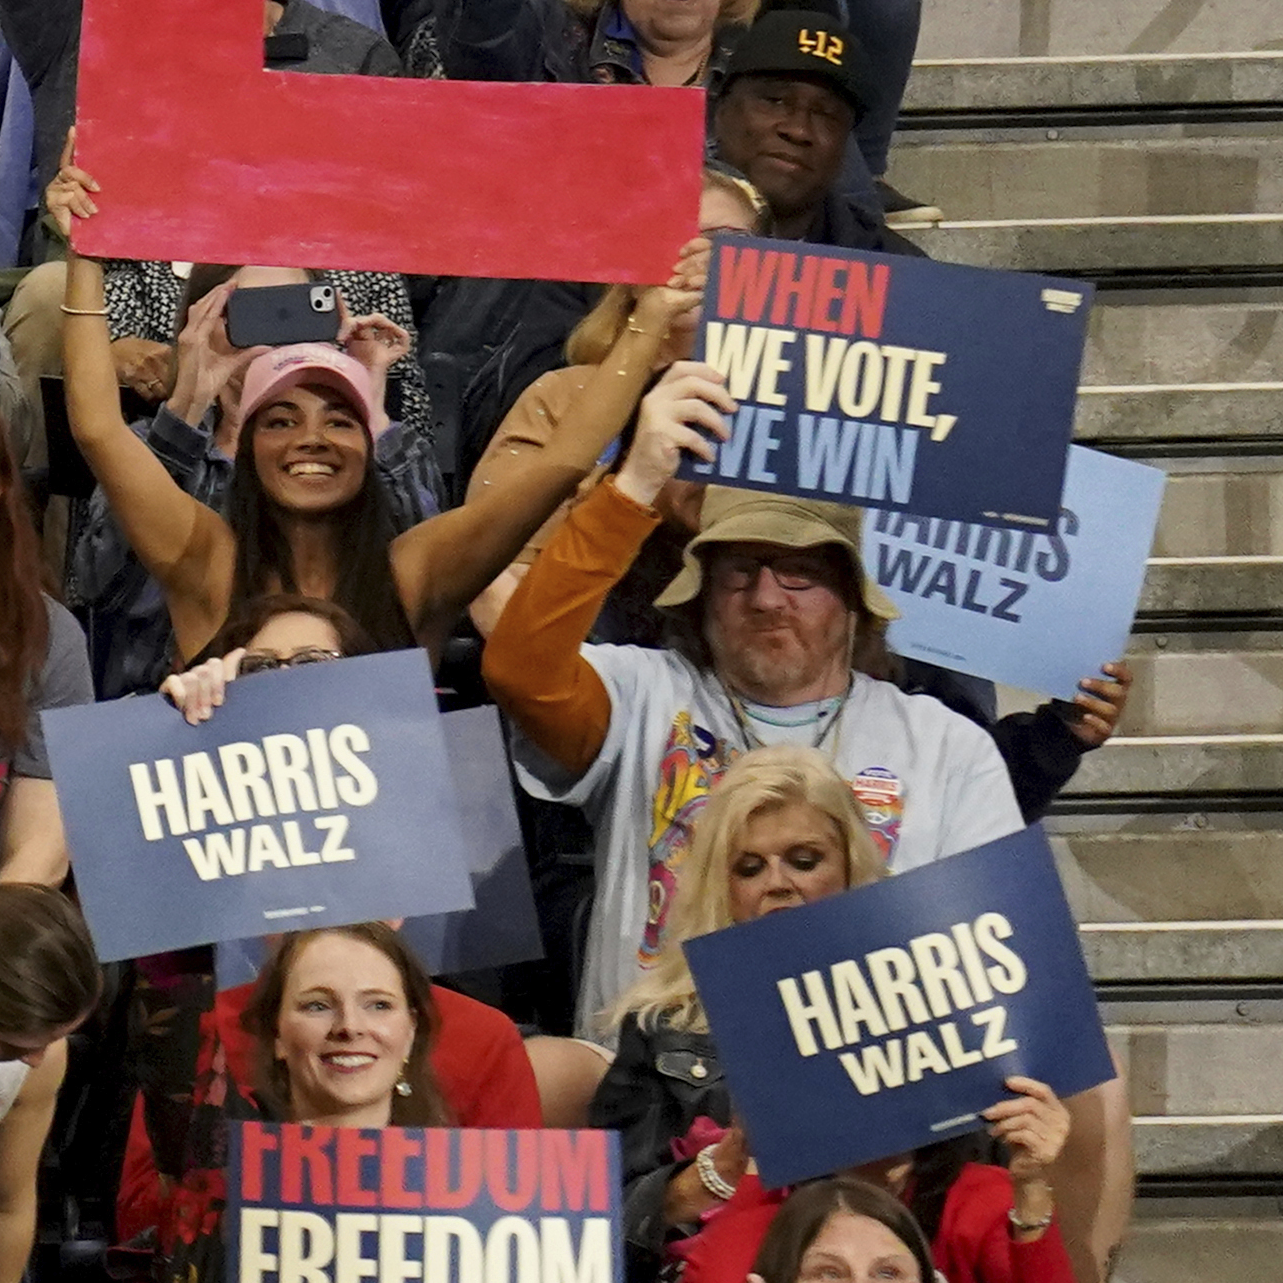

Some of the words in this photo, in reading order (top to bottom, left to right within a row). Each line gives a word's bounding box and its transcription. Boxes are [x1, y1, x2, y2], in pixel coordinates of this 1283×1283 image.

[717, 245, 892, 339] WHEN
[706, 320, 798, 406] WE
[804, 336, 959, 442] VOTE,
[796, 413, 920, 506] WIN
[876, 543, 1029, 624] WALZ
[130, 723, 379, 842] HARRIS
[182, 814, 357, 882] WALZ
[777, 912, 1028, 1058] HARRIS
[839, 1005, 1018, 1096] WALZ
[240, 1121, 610, 1212] FREEDOM
[239, 1206, 613, 1283] FREEDOM
